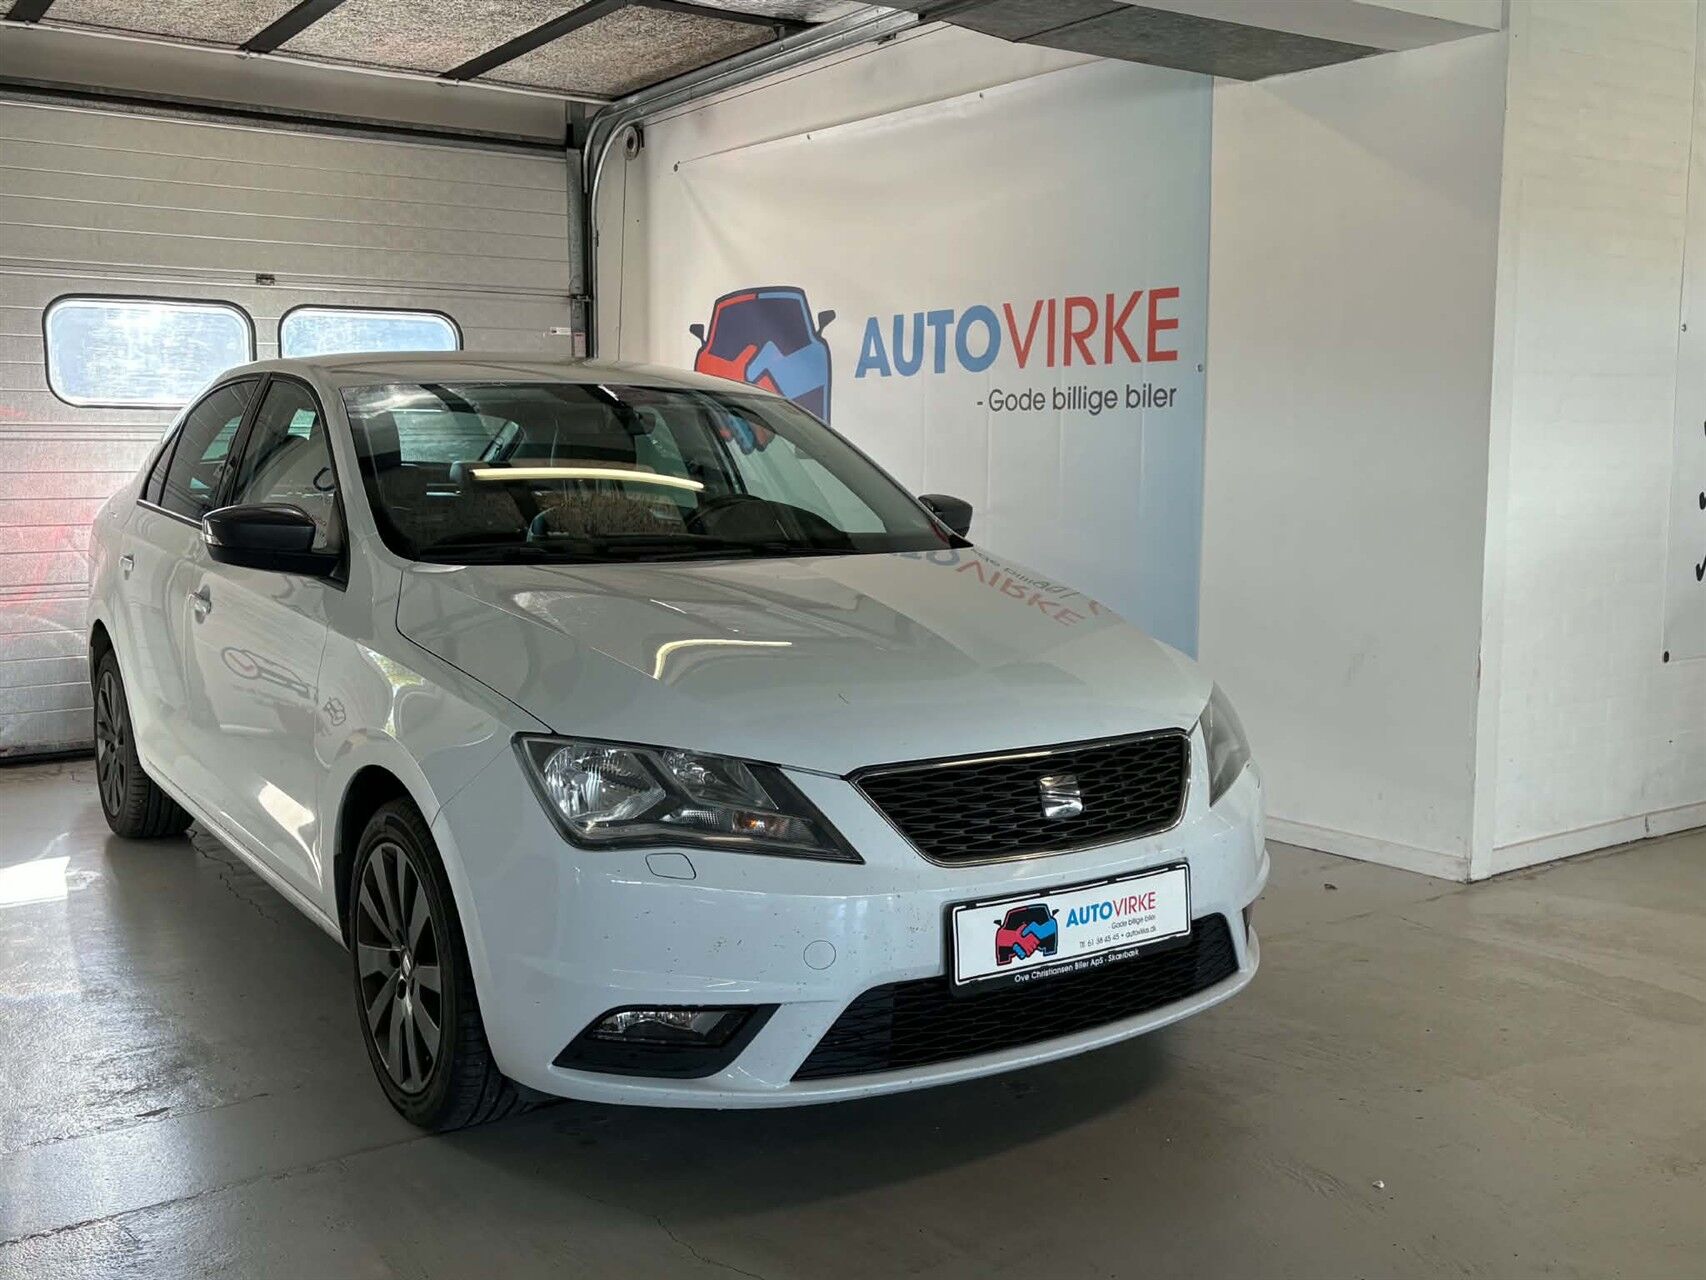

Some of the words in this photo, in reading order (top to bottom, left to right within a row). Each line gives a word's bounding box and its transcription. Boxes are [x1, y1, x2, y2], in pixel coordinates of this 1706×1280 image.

[854, 286, 1180, 378] AUTOVIRKE
[988, 388, 1046, 412] Gode
[1052, 384, 1119, 416] billige
[1125, 382, 1177, 409] biler
[1066, 891, 1156, 928] AUTOVIRKE
[1014, 973, 1030, 983] Ove
[1031, 964, 1074, 979] Christiansen
[1074, 961, 1089, 971] Biler
[1090, 956, 1104, 967] ApS
